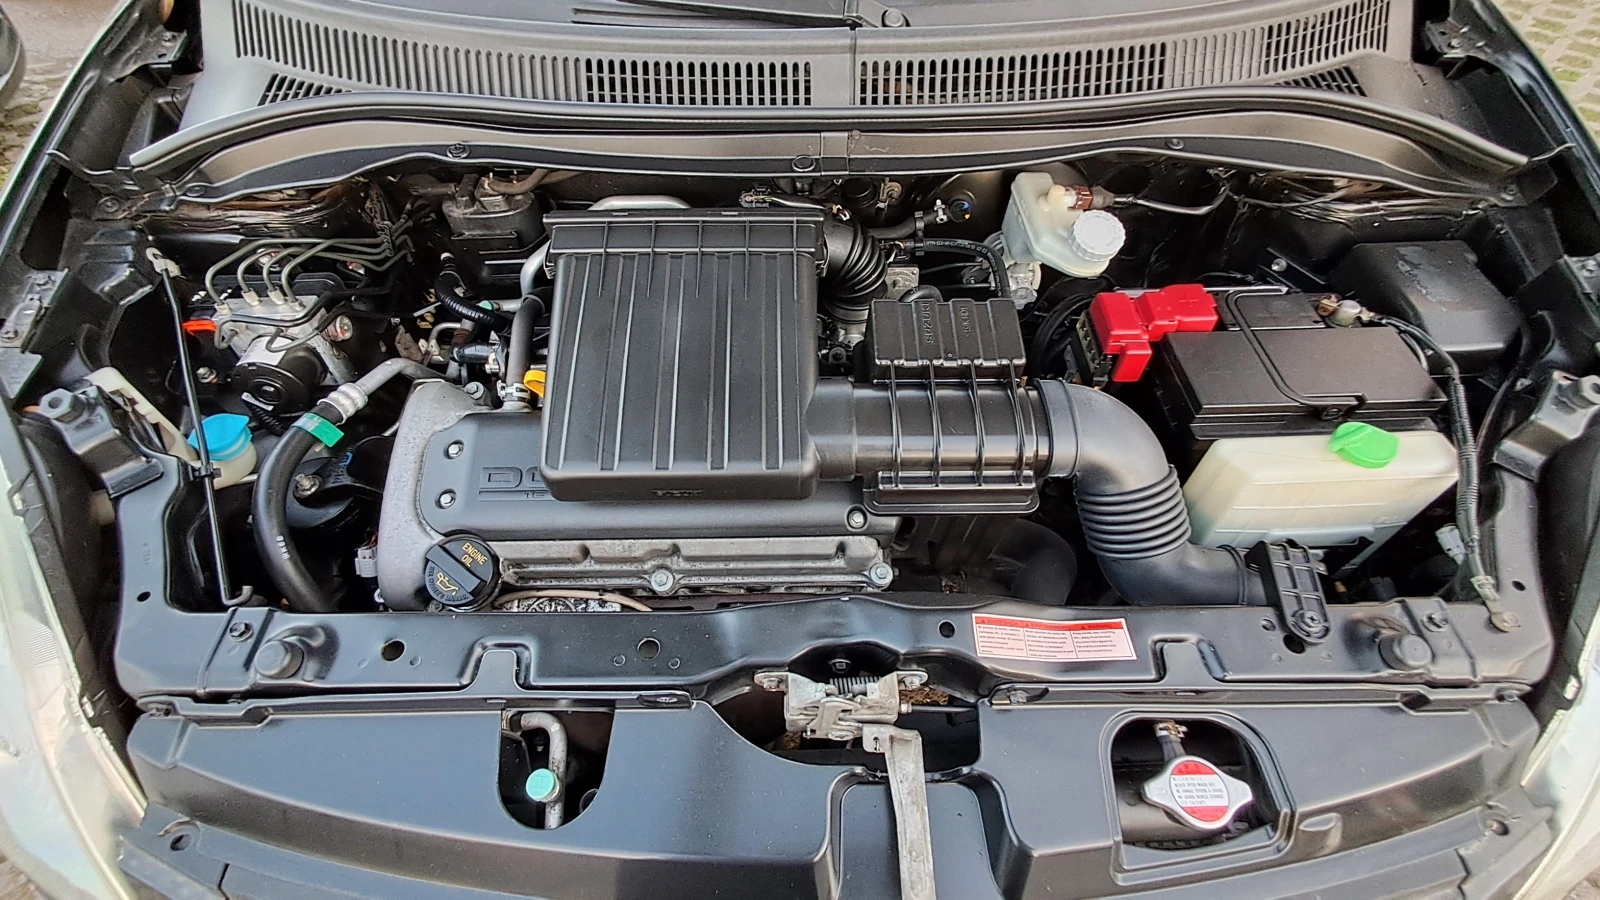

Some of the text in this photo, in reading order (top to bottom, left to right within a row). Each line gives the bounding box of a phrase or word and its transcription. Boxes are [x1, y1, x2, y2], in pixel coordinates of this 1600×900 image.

[921, 303, 934, 344] SUZUKI
[461, 555, 474, 568] OIL
[462, 542, 488, 565] ENGINE
